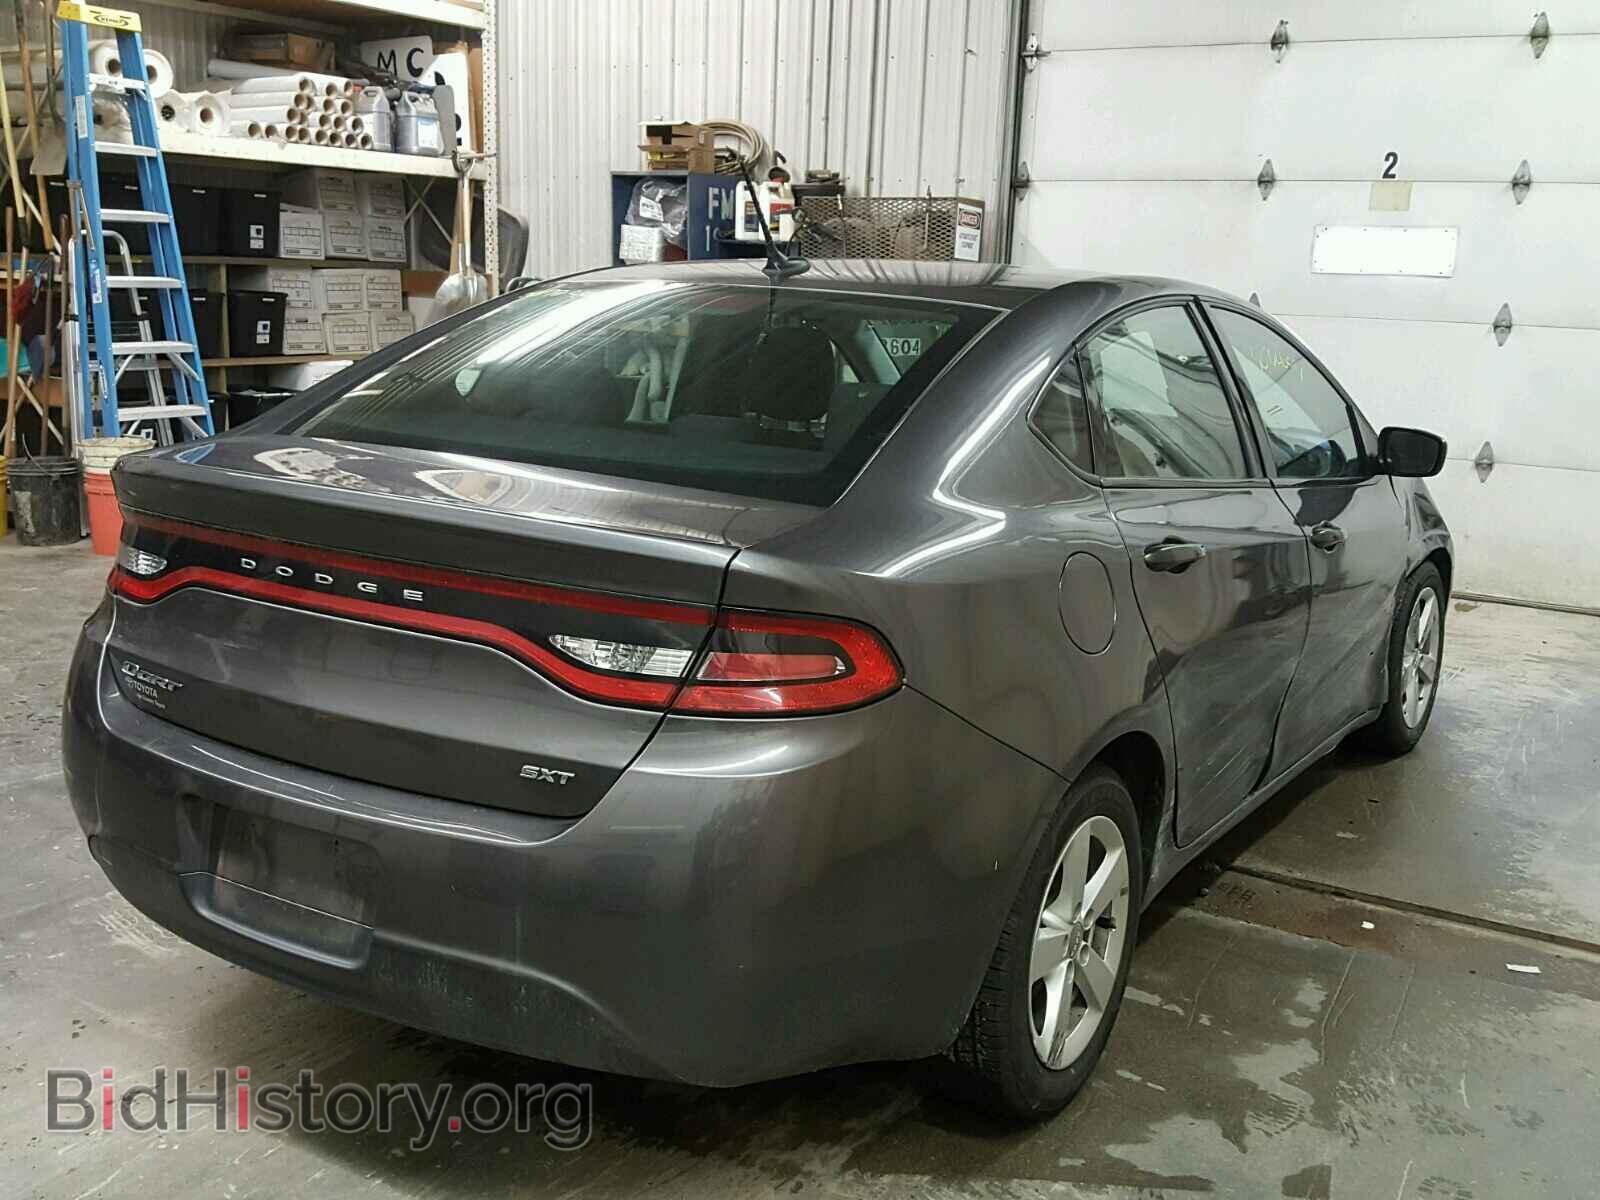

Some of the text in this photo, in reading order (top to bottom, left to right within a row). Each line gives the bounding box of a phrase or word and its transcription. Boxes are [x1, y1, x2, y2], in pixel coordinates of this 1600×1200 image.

[1382, 151, 1399, 179] 2
[881, 338, 920, 355] 604
[240, 556, 425, 602] DODGE
[133, 679, 158, 699] TOYOTA
[519, 764, 576, 785] SXT
